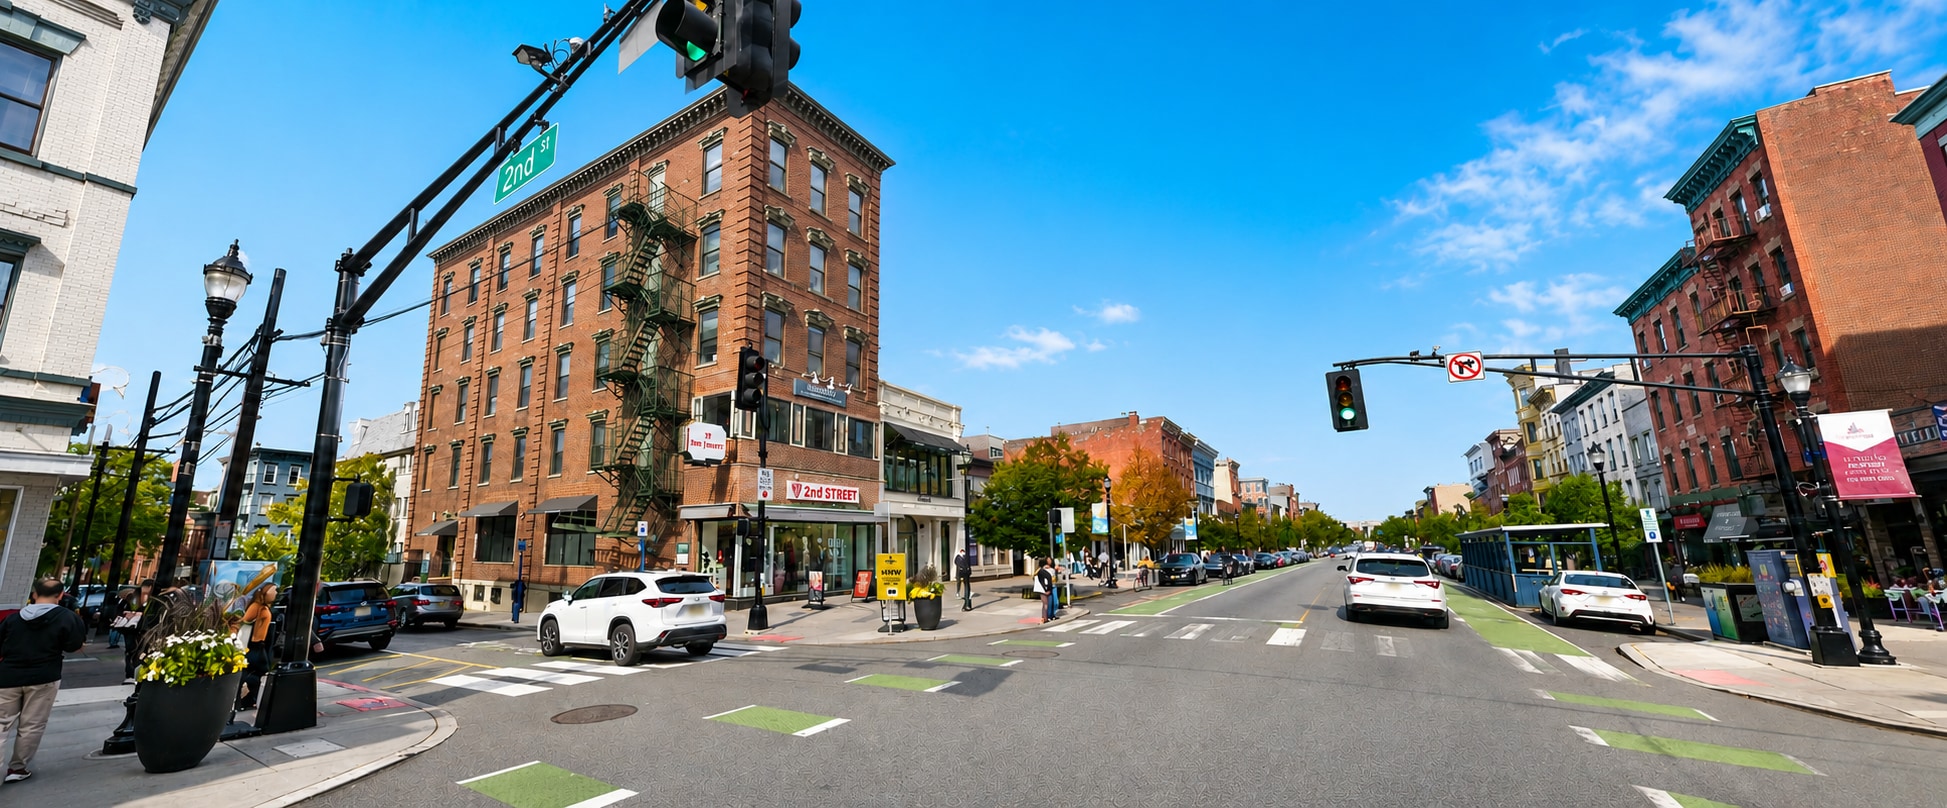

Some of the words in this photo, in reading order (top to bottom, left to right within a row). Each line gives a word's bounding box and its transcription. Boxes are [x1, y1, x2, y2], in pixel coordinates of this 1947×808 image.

[502, 146, 535, 193] 2nd
[804, 485, 823, 499] 2nd
[825, 487, 858, 501] STREET
